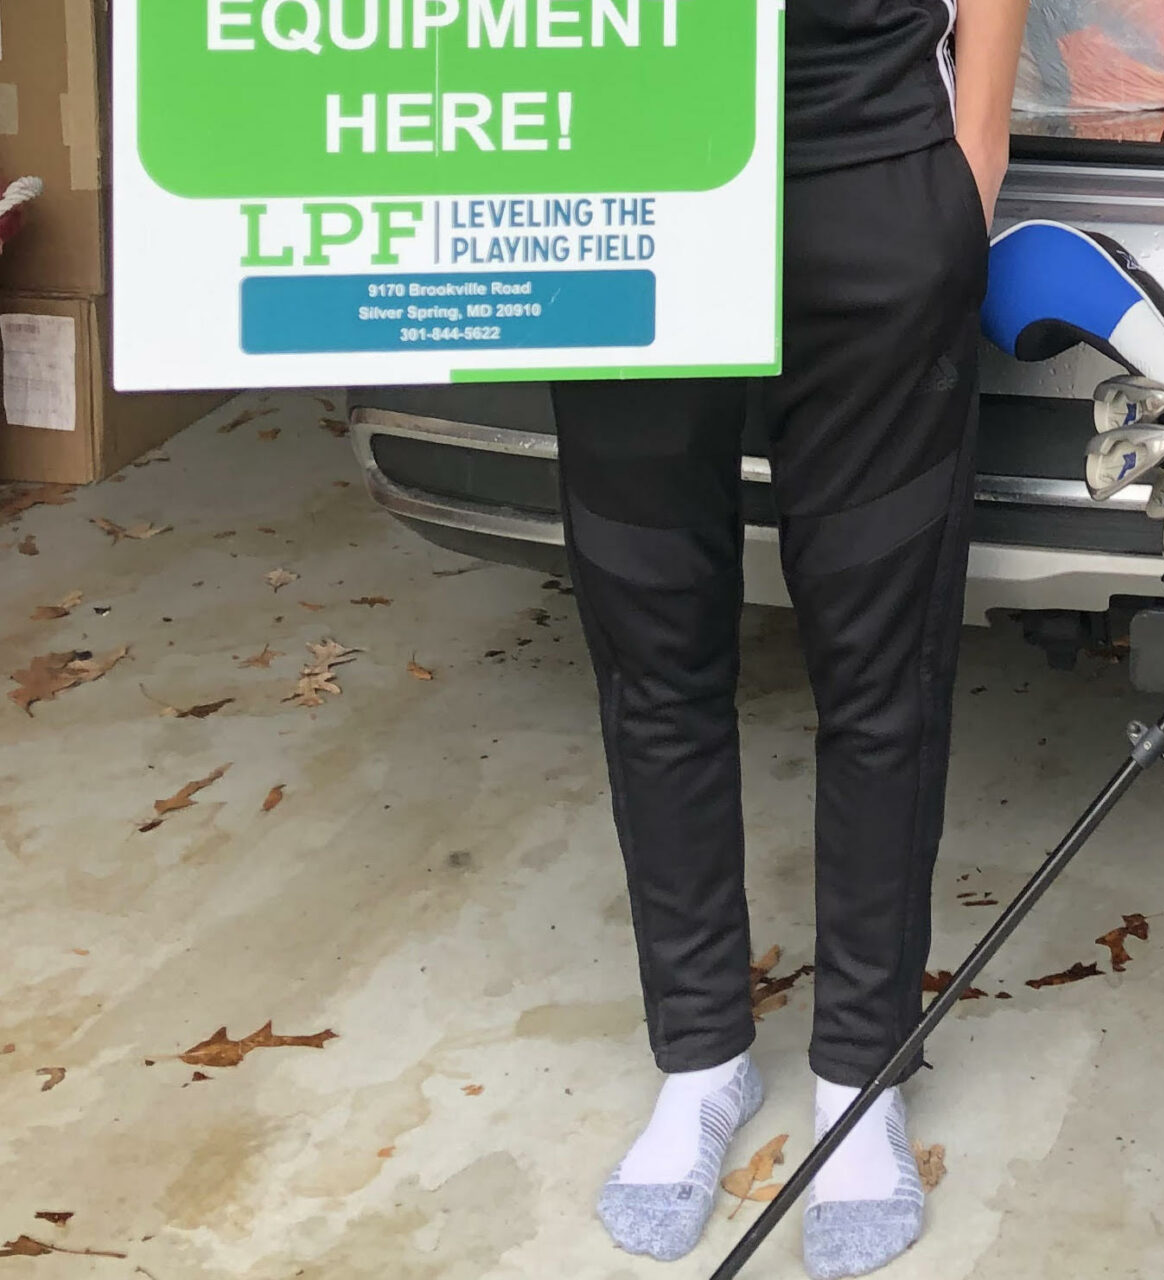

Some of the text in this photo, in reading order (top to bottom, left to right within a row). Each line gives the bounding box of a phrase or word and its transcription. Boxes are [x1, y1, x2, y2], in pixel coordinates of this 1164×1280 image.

[326, 91, 573, 153] HERE!
[451, 197, 656, 228] LEVELING THE
[240, 201, 424, 267] LPF
[451, 234, 656, 263] PLAYING FIELD
[368, 281, 532, 298] 9170 Brookville Road
[358, 303, 542, 321] Silver Spring, MD 20910
[399, 326, 501, 342] 301-844-5622
